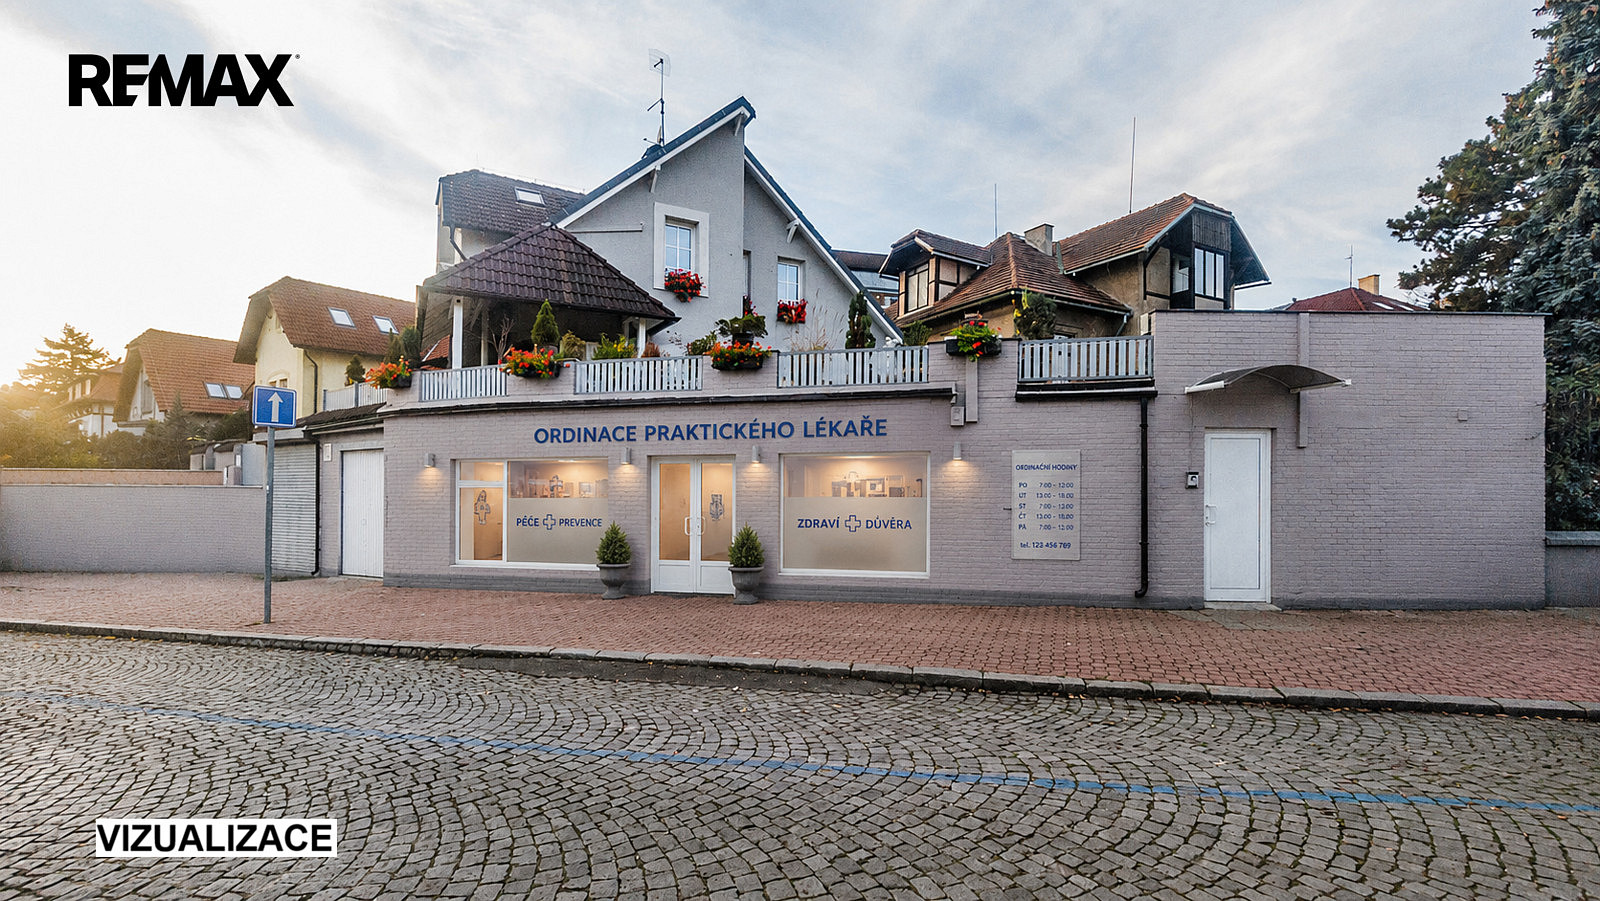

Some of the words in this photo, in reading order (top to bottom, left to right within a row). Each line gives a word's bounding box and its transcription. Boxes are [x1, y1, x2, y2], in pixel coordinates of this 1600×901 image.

[534, 425, 637, 444] ORDINACE
[644, 418, 795, 441] PRAKTICKÉHO
[803, 415, 888, 438] LÉKAŘE
[559, 518, 603, 527] PREVENCE
[797, 516, 840, 529] ZDRAVÍ
